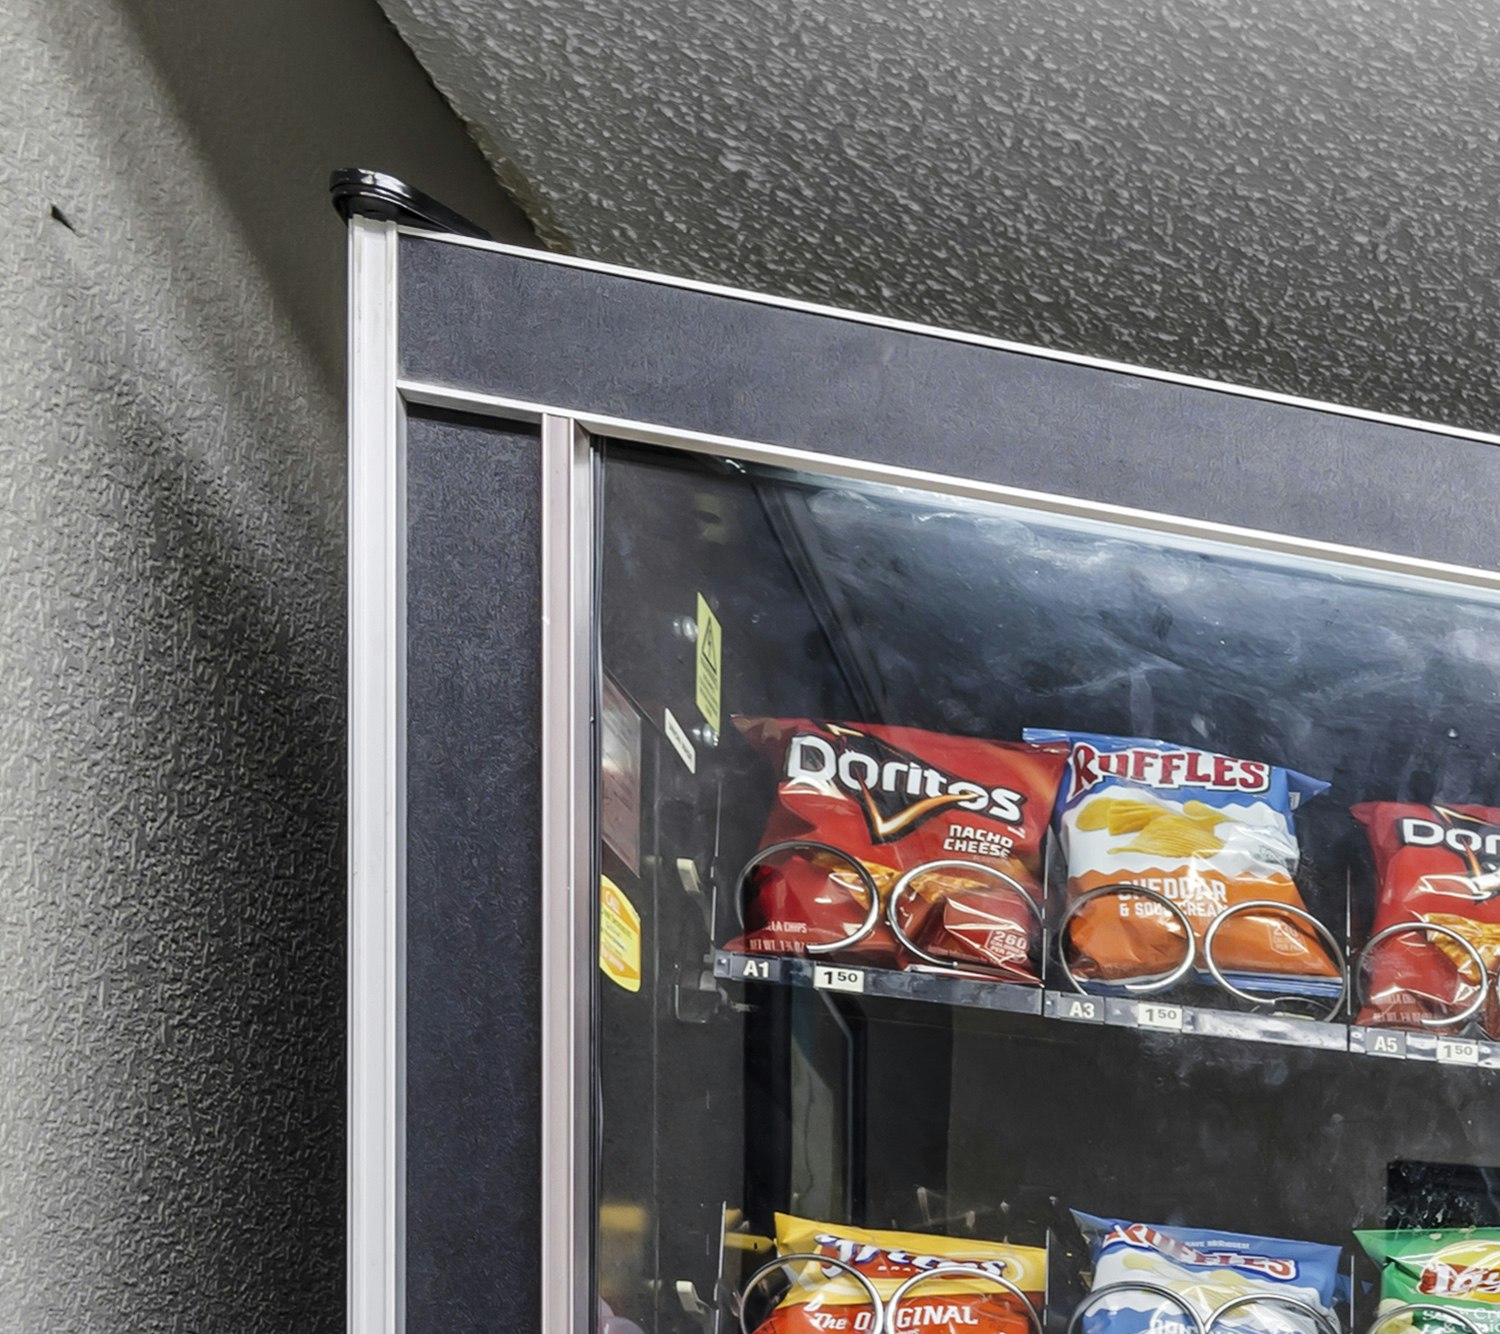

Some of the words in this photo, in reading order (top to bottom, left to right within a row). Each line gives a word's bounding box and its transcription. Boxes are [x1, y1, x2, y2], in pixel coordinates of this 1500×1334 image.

[787, 734, 1022, 822] Doritos
[1073, 745, 1267, 790] RUFFLES
[949, 825, 1014, 847] NACHO
[943, 838, 1011, 859] CHEESE
[1120, 903, 1129, 917] &
[743, 959, 769, 978] A1
[1069, 1001, 1095, 1019] A3
[1374, 1036, 1397, 1053] A5
[811, 1312, 848, 1332] The
[853, 1304, 979, 1332] OGINAL
